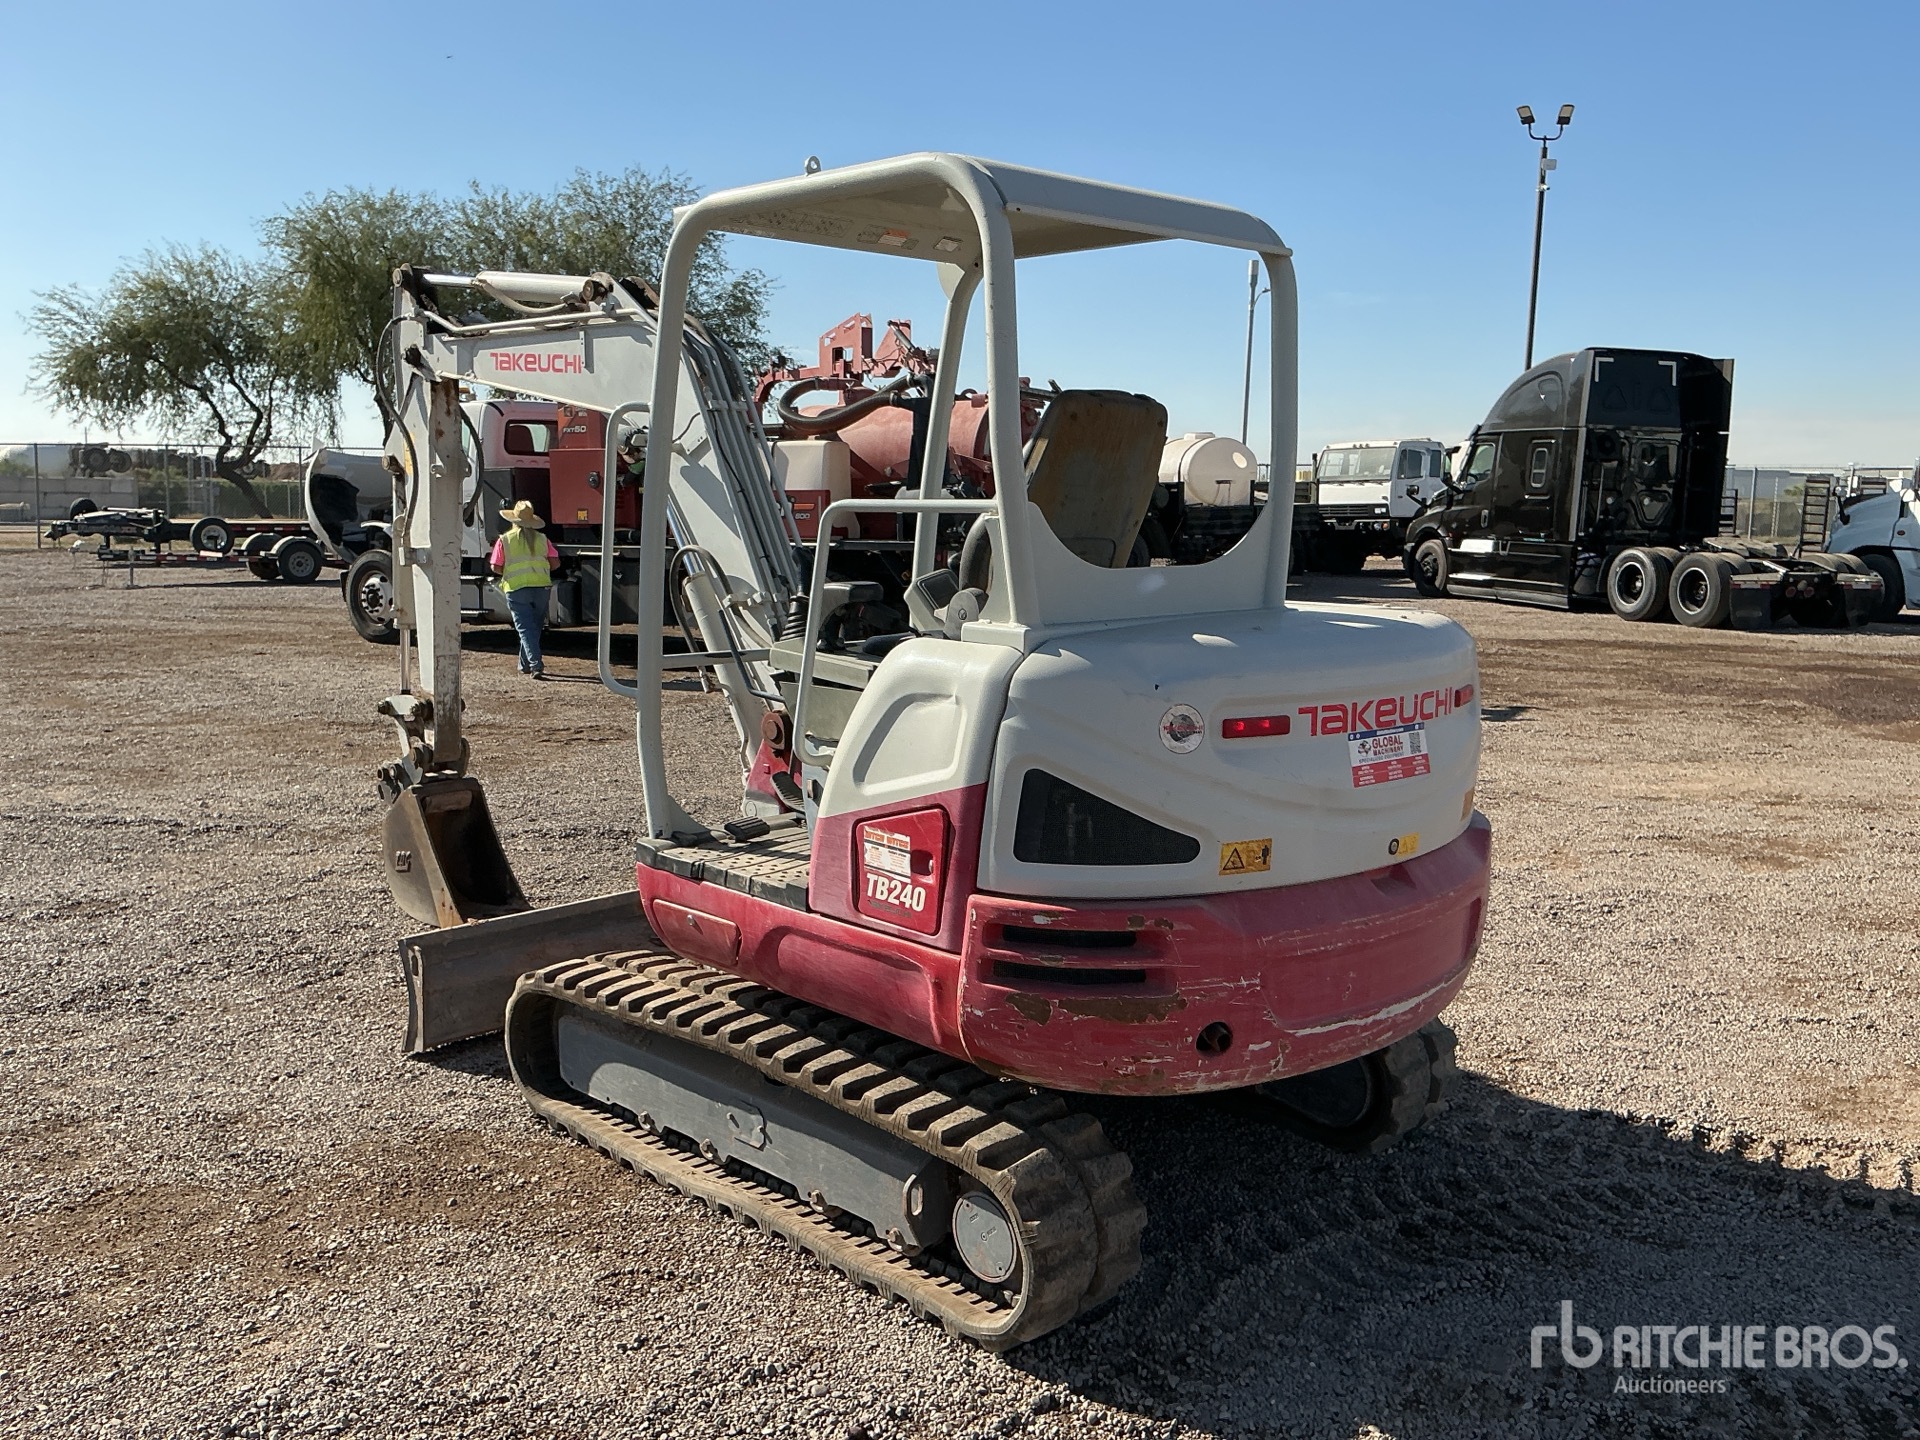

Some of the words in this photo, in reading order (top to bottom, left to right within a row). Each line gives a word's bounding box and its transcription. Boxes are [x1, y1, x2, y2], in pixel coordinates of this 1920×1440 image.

[490, 352, 582, 374] TAKEUCHI
[1298, 687, 1453, 736] TAKEUCHI
[1372, 735, 1404, 749] GLOBAL
[866, 872, 926, 912] TB240
